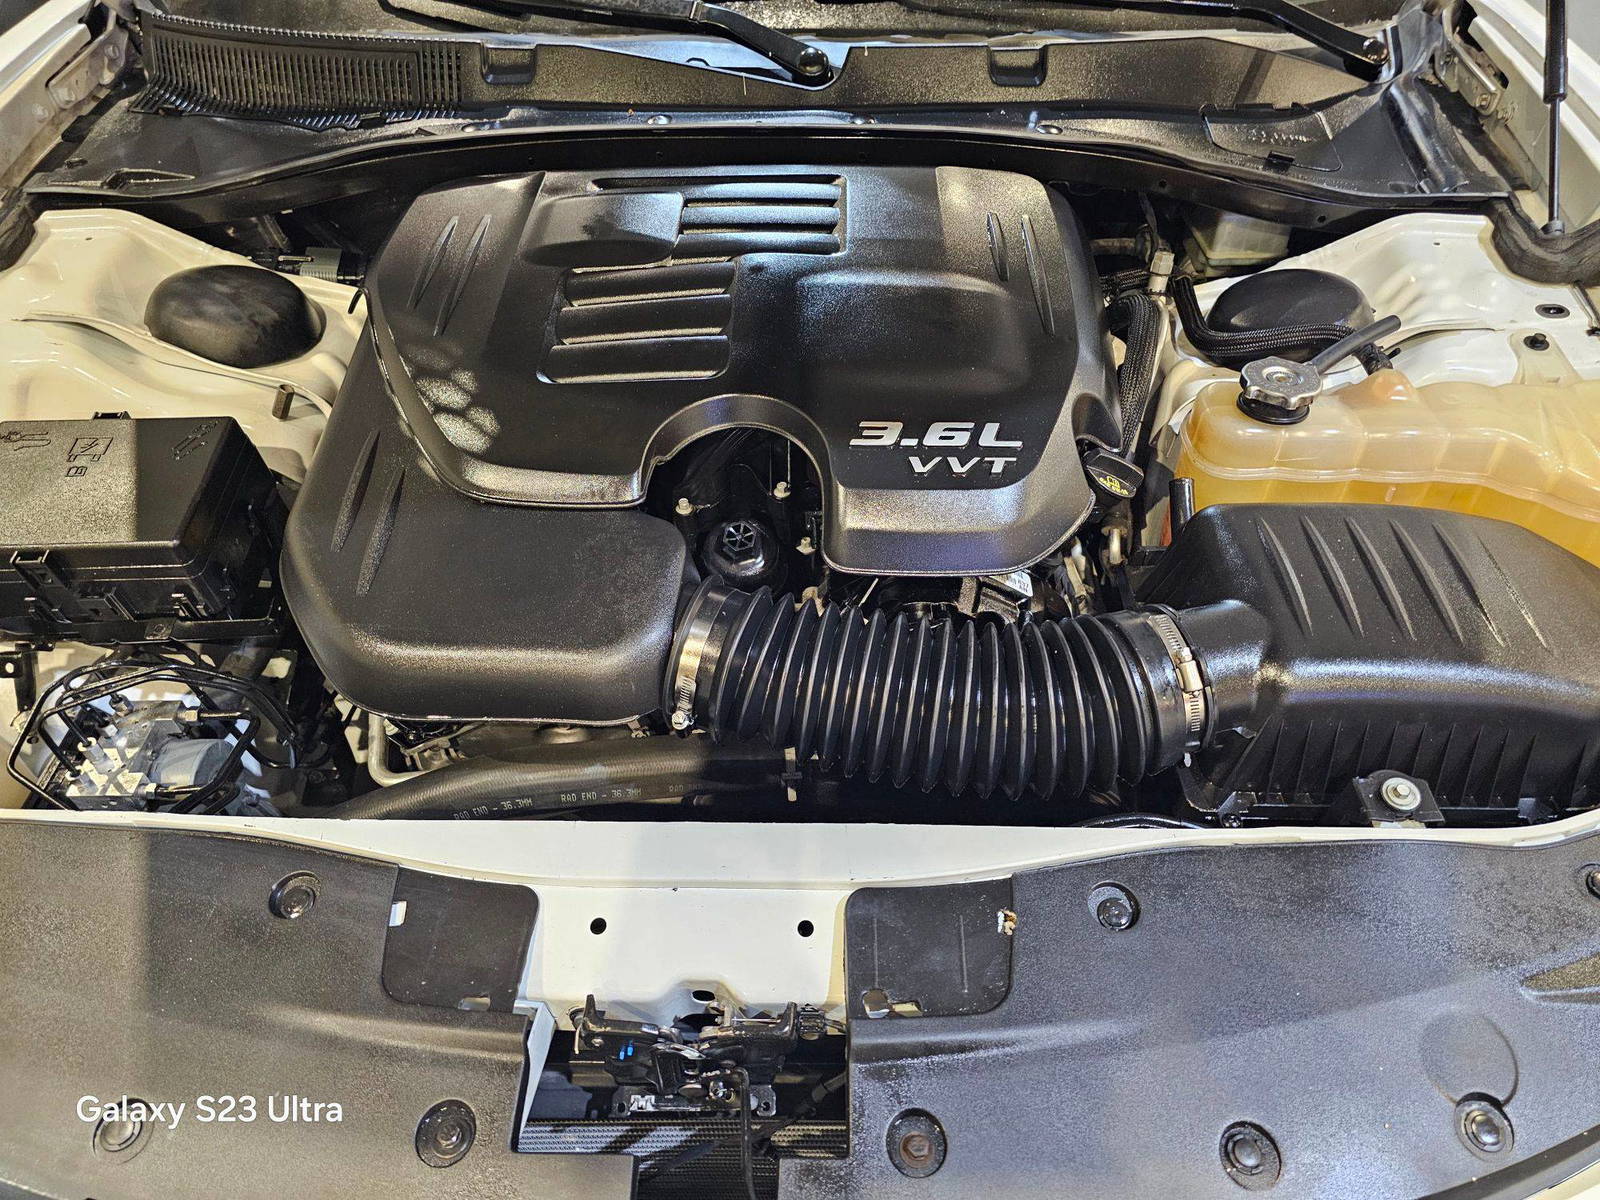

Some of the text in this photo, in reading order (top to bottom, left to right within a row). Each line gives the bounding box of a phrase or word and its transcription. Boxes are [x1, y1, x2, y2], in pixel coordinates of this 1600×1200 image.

[849, 421, 1023, 448] 3.6L
[907, 456, 1017, 474] VVT
[560, 793, 577, 803] RAD
[581, 791, 597, 801] END
[611, 788, 642, 798] 36.3MM
[472, 805, 489, 817] END
[500, 797, 533, 811] 36.3MM
